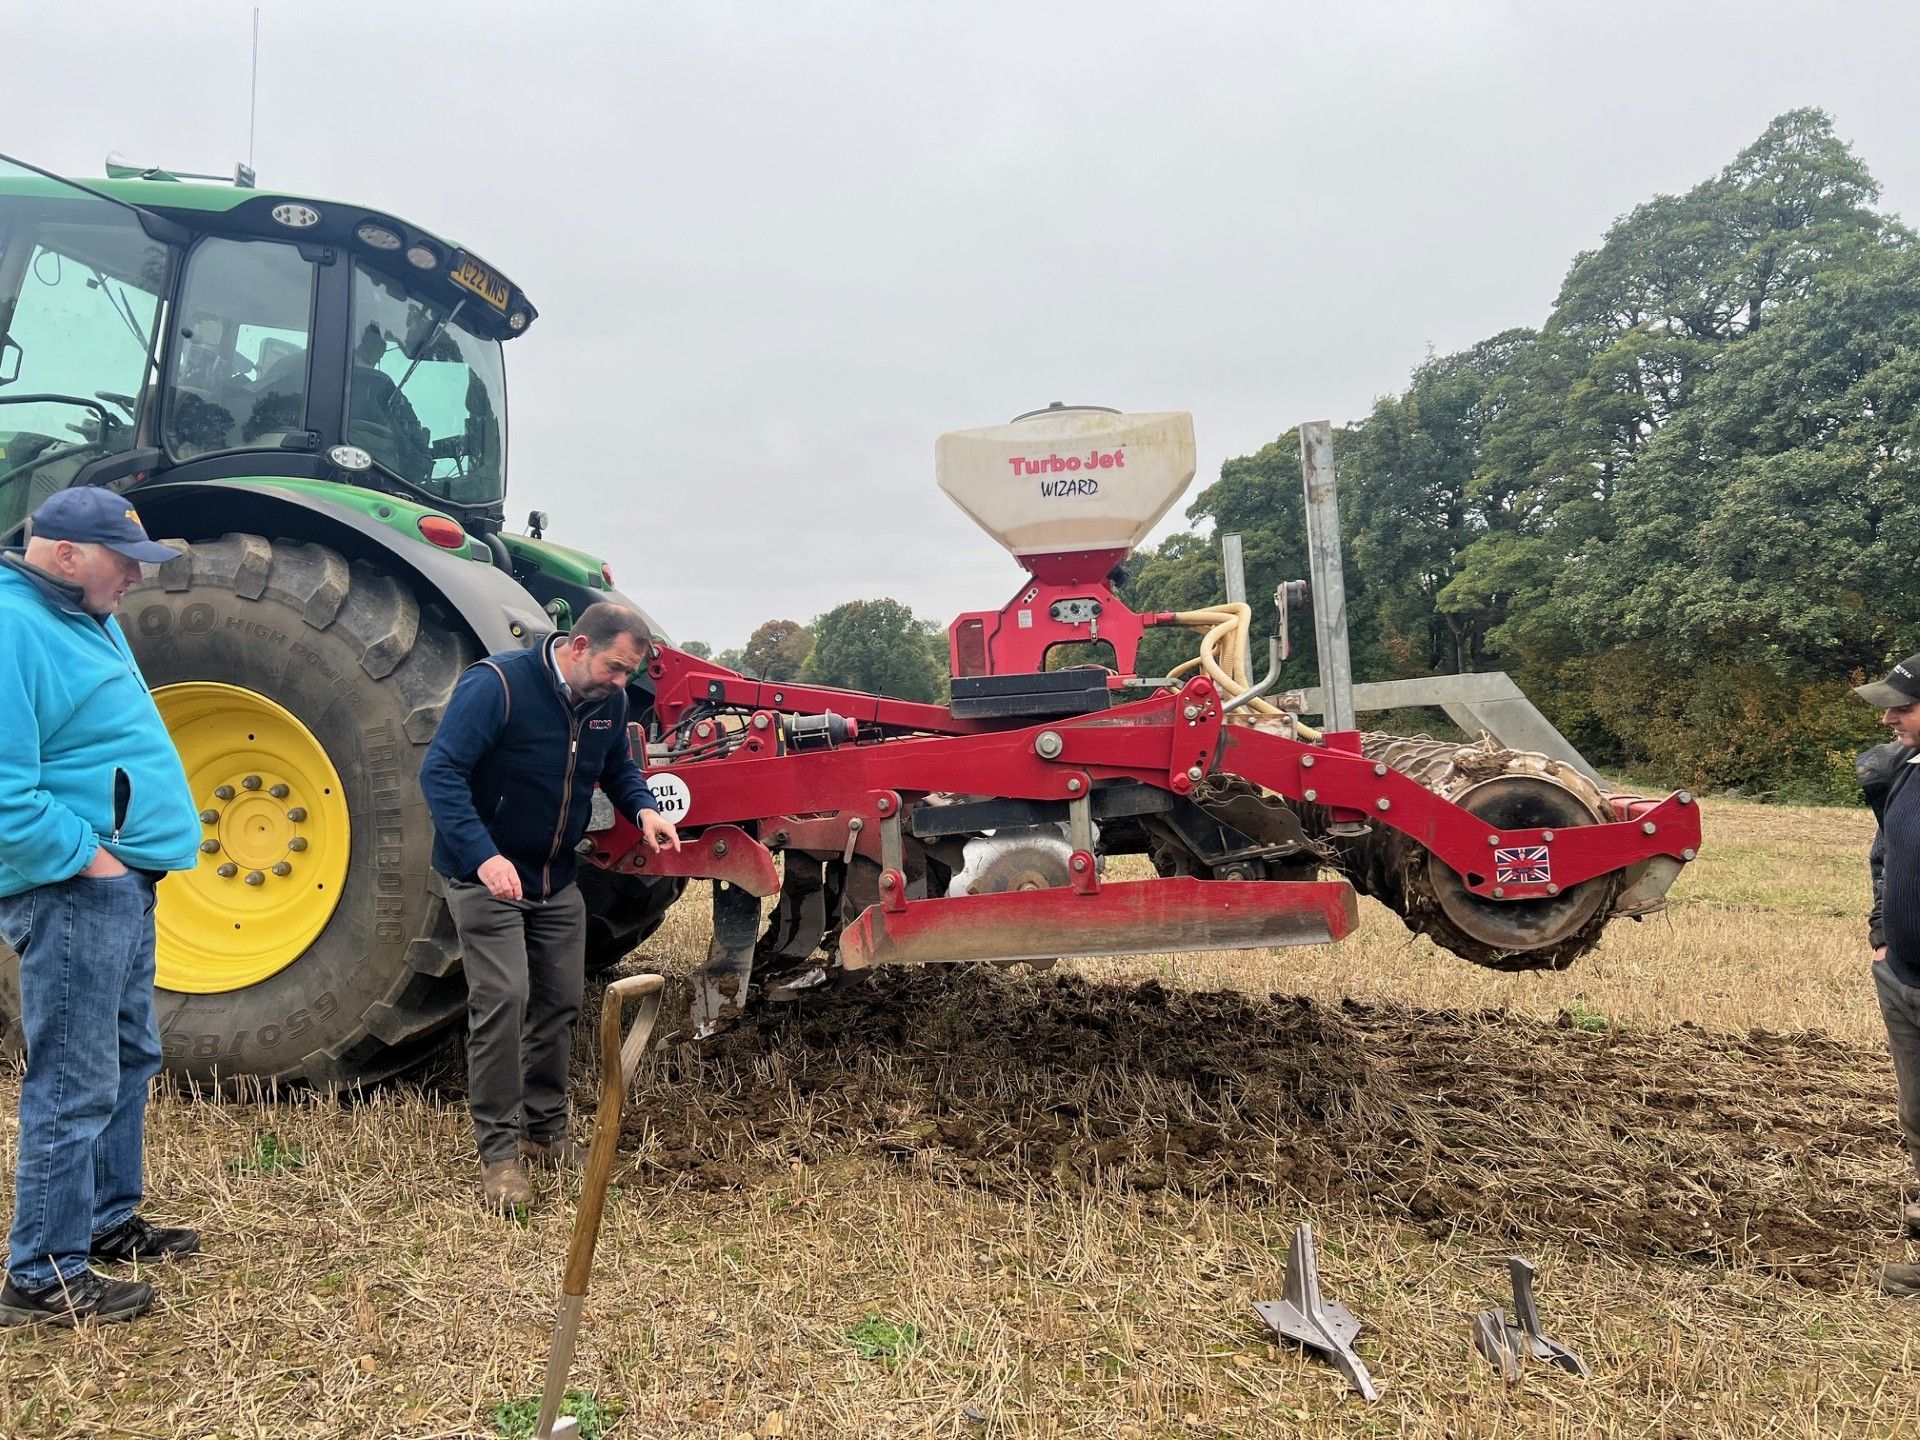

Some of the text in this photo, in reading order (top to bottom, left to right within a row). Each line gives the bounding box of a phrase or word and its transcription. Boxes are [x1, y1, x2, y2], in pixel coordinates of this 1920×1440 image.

[458, 259, 485, 290] C22
[1009, 449, 1125, 476] Turbo Jet
[1041, 478, 1099, 498] WIZARD
[650, 785, 677, 797] CUL
[365, 718, 405, 945] TRELLEBORG
